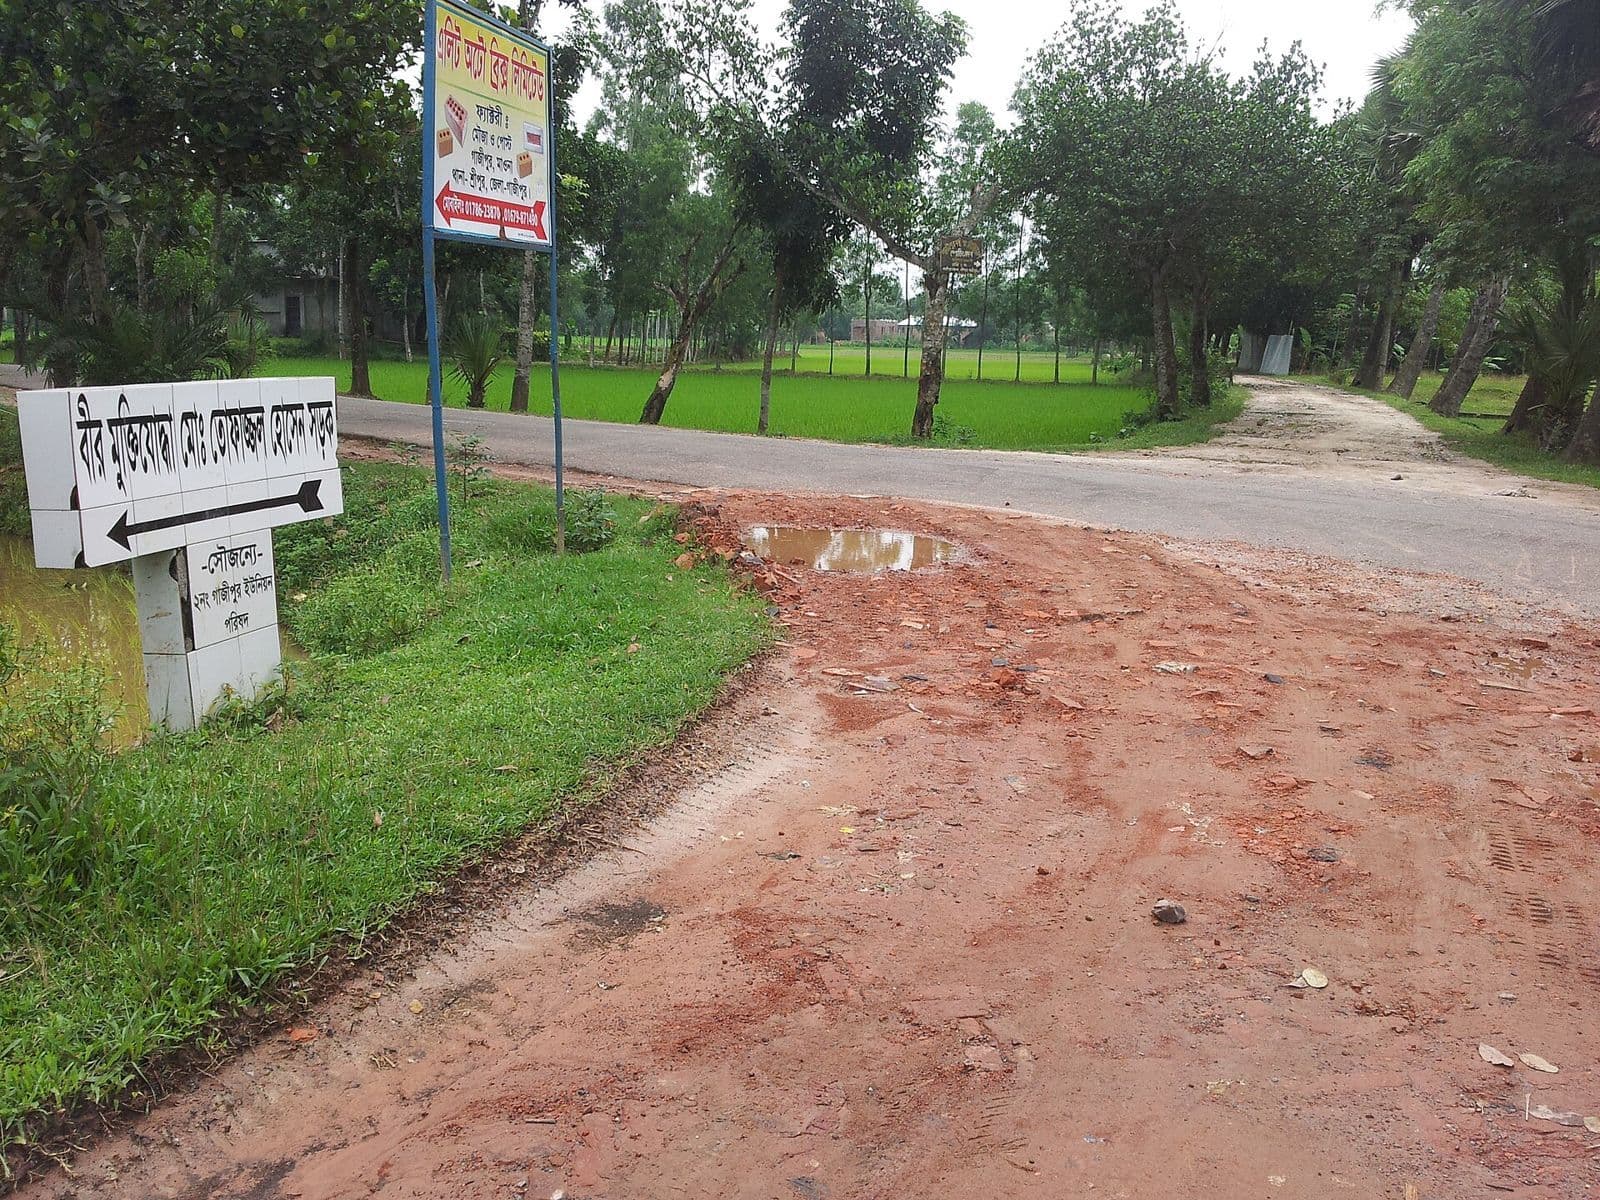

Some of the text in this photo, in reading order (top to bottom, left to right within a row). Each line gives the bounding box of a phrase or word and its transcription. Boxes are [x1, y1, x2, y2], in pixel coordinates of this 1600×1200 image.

[437, 15, 544, 102] এলিট অটো ব্রিক্স লিমিটেড
[76, 392, 334, 496] বীর মুক্তিযোদ্ধা মোঃ তোফাজ্জল হোসেন সড়ক
[194, 572, 274, 612] ২নং গাজীপুর ইউনিয়ন
[224, 610, 249, 634] পরিষদ
